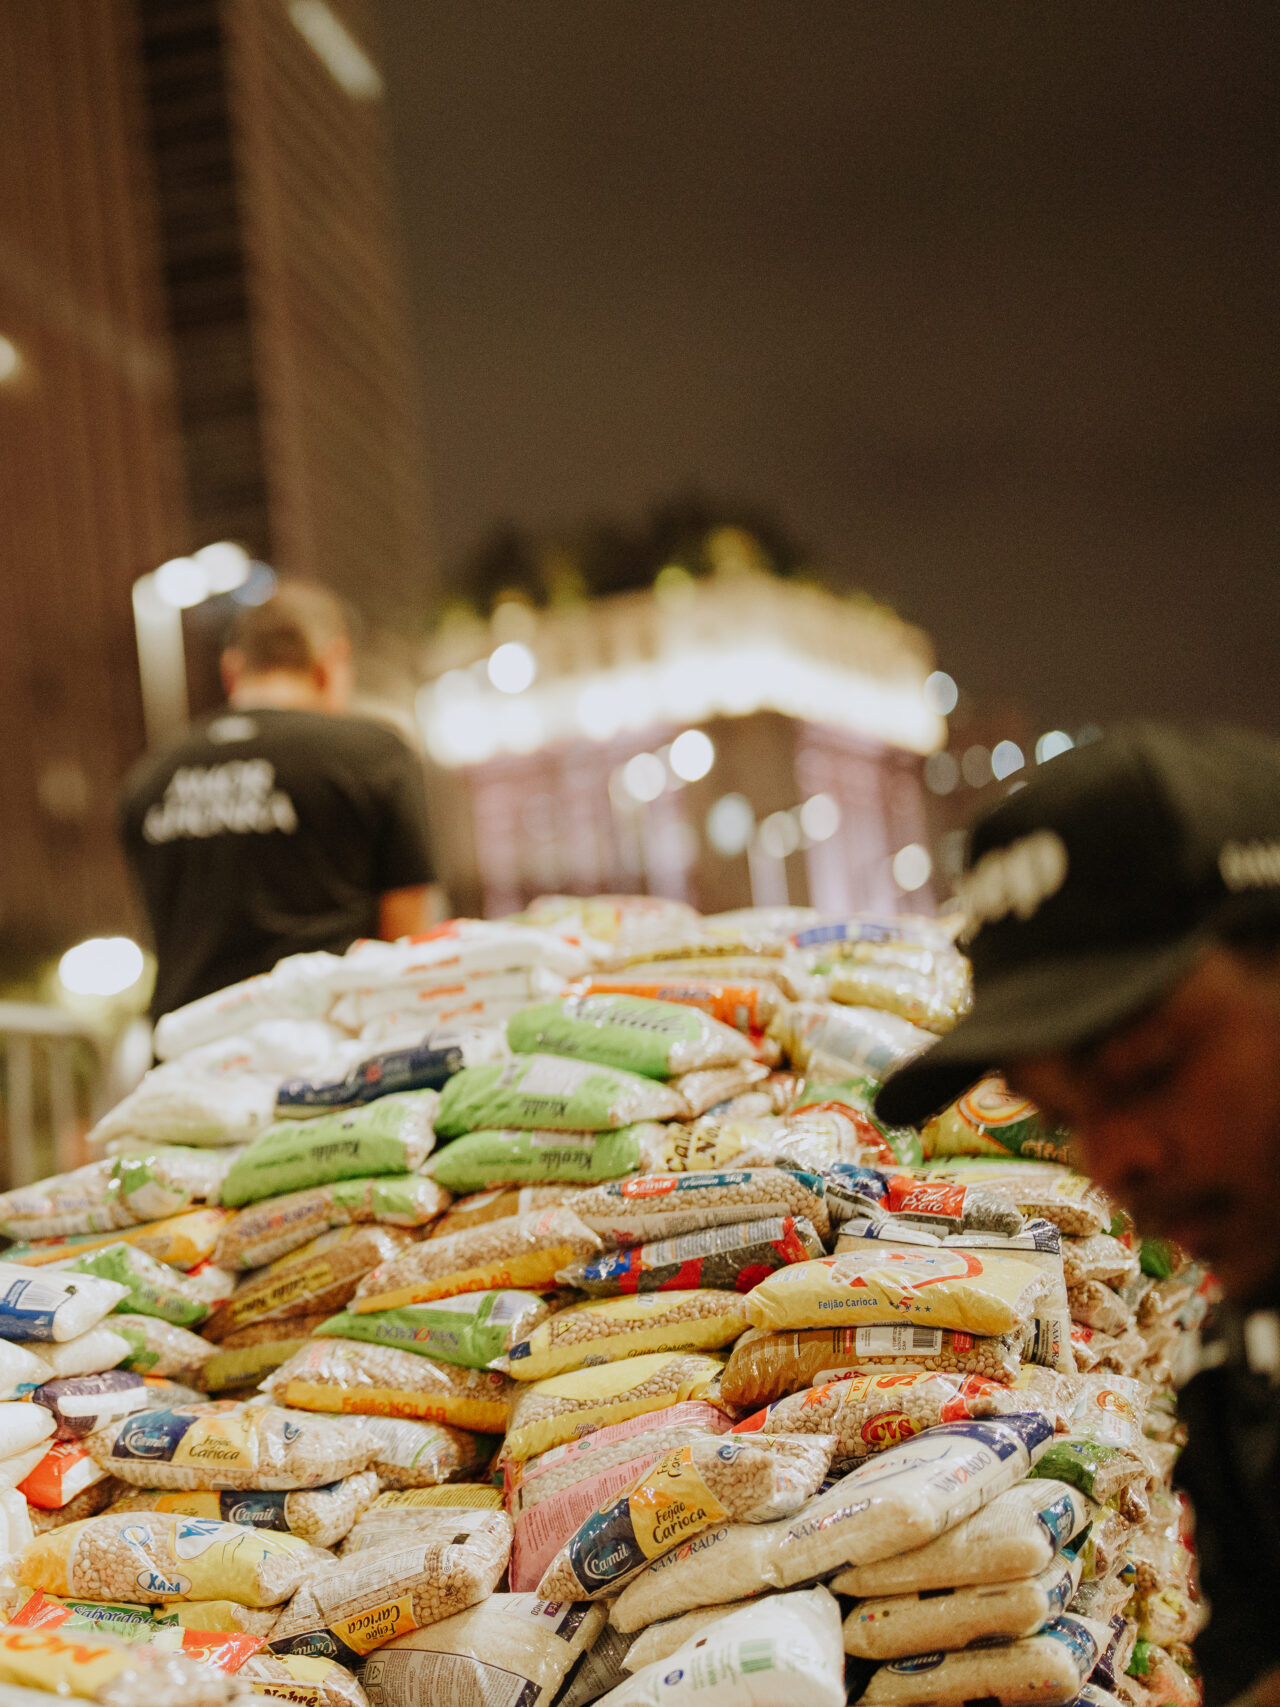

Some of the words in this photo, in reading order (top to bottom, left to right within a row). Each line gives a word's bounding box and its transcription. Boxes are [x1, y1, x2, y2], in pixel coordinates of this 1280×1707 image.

[818, 1299, 844, 1310] Feijão
[845, 1297, 878, 1308] Carioca
[870, 1417, 916, 1444] CVS
[189, 1443, 240, 1460] Carioca
[235, 1505, 277, 1523] Camil
[651, 1506, 708, 1544] Carioca
[655, 1500, 687, 1526] Feijão
[590, 1543, 630, 1575] Camil
[647, 1527, 729, 1576] NAMORADO
[347, 1605, 401, 1635] Carioca
[366, 1622, 397, 1641] Feijão
